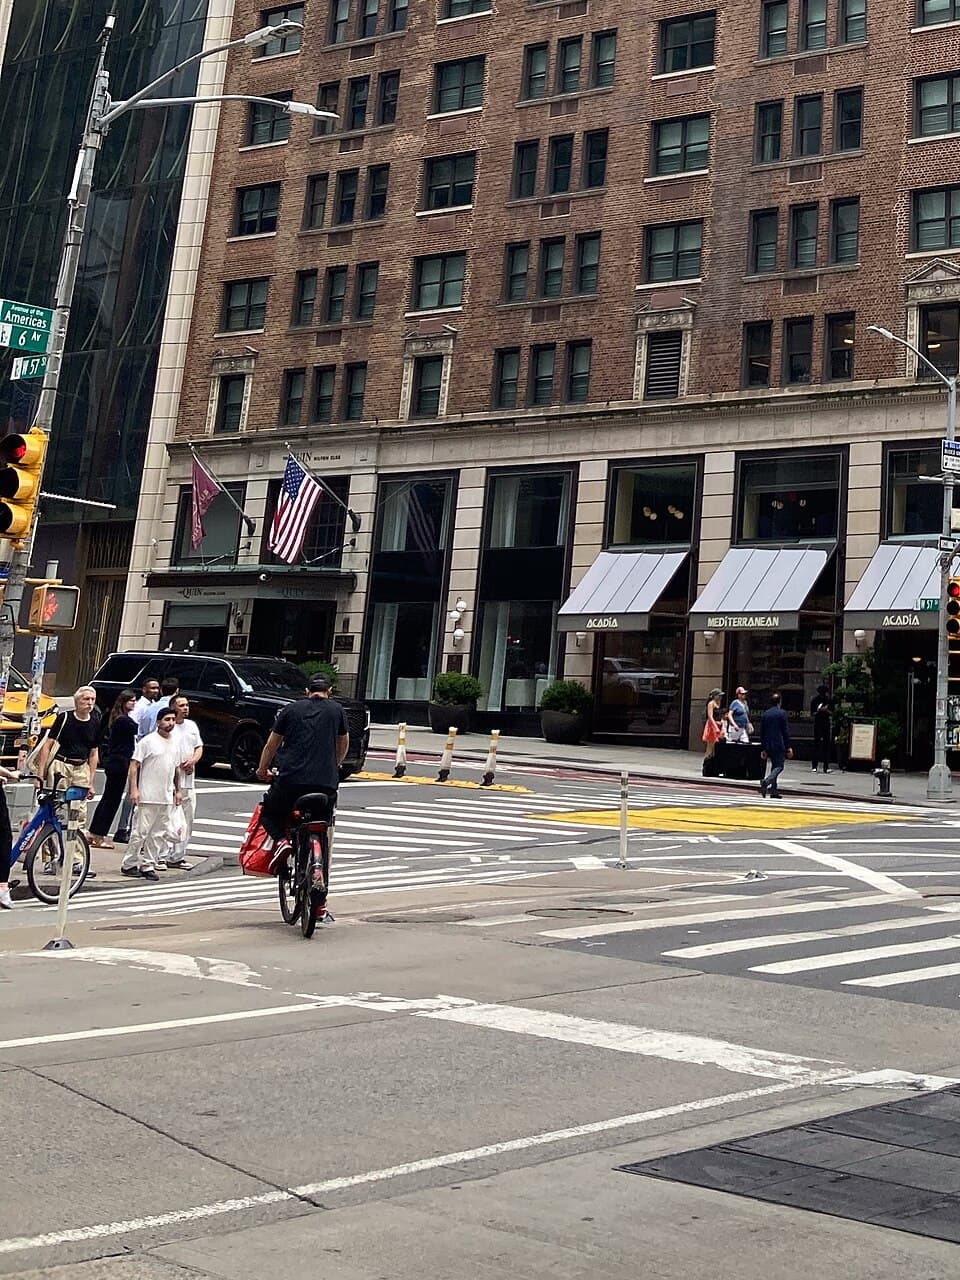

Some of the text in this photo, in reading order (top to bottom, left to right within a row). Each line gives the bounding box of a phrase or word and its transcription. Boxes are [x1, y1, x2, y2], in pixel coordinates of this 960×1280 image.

[11, 304, 29, 314] Avenue
[4, 310, 47, 329] Americas
[18, 330, 41, 346] 6 Av
[21, 360, 30, 376] W
[30, 358, 40, 375] 57
[927, 601, 933, 610] 57
